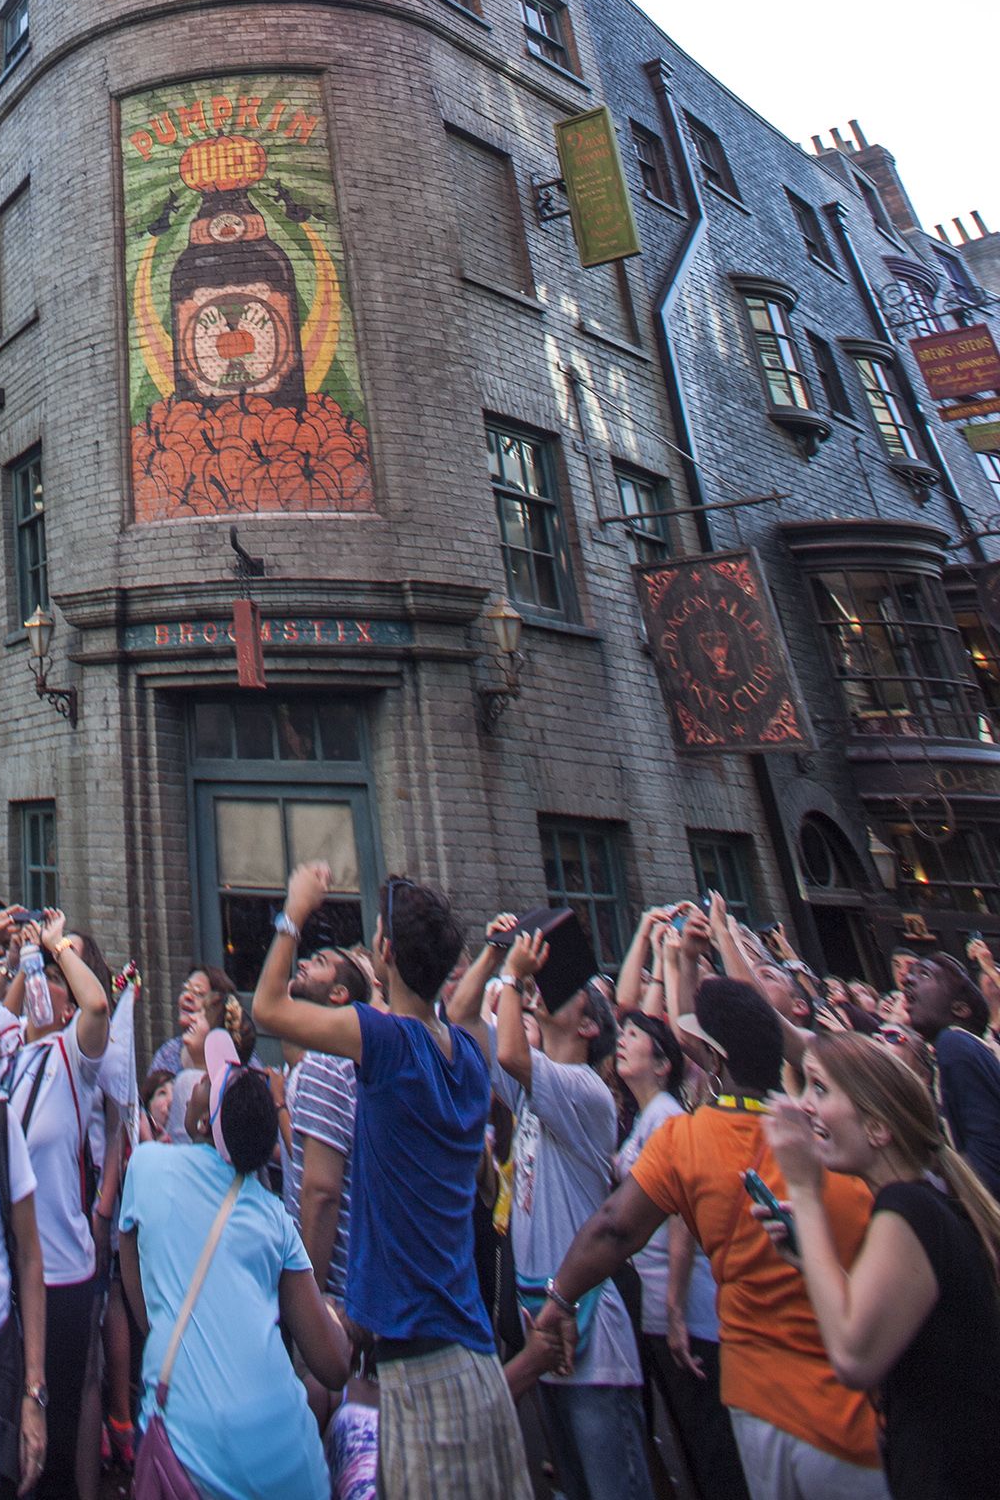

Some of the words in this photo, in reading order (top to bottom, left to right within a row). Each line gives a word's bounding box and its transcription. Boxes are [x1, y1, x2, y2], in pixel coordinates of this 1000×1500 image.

[129, 95, 319, 162] PUMPKIN
[185, 141, 261, 185] JUICE
[918, 345, 953, 362] BREWS
[957, 335, 992, 353] STEWS
[660, 592, 712, 651] DIAGON
[718, 596, 771, 643] ALLEY
